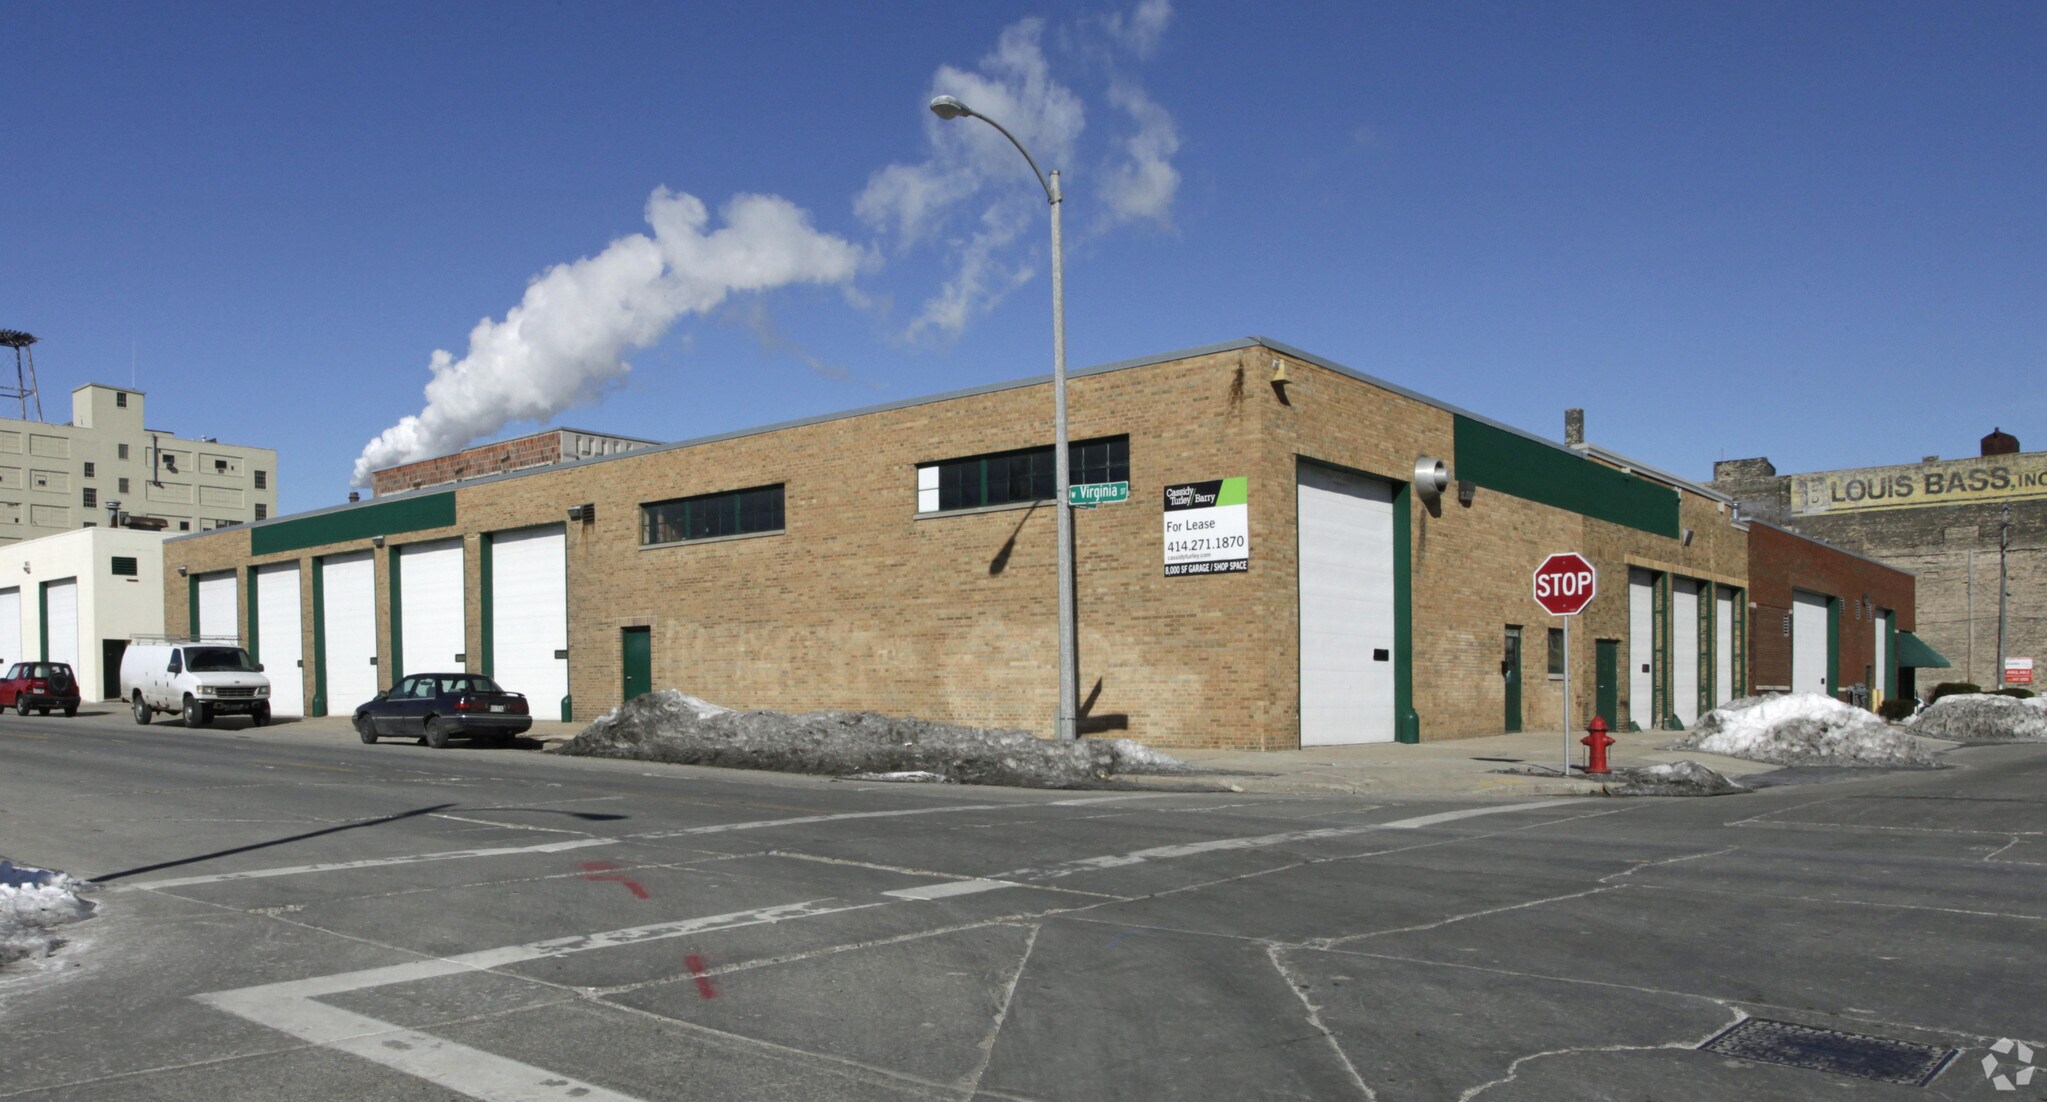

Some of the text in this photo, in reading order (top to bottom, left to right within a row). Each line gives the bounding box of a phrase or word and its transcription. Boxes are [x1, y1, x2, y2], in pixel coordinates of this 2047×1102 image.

[1166, 487, 1194, 497] Cassidy
[1831, 475, 1914, 503] LOUIS
[1924, 466, 2016, 495] BASS,
[2018, 471, 2047, 488] INC
[1080, 484, 1117, 502] Virginia
[1120, 487, 1126, 495] ST
[1170, 495, 1192, 506] Turley
[1195, 494, 1216, 504] Barry
[1166, 520, 1216, 533] For Lease
[1167, 535, 1245, 552] 414.271.1870
[1165, 565, 1181, 576] 8,000
[1181, 565, 1188, 574] SF
[1188, 563, 1210, 573] GARAGE
[1214, 562, 1229, 572] SHOP
[1229, 560, 1247, 571] SPACE
[1537, 571, 1592, 597] STOP
